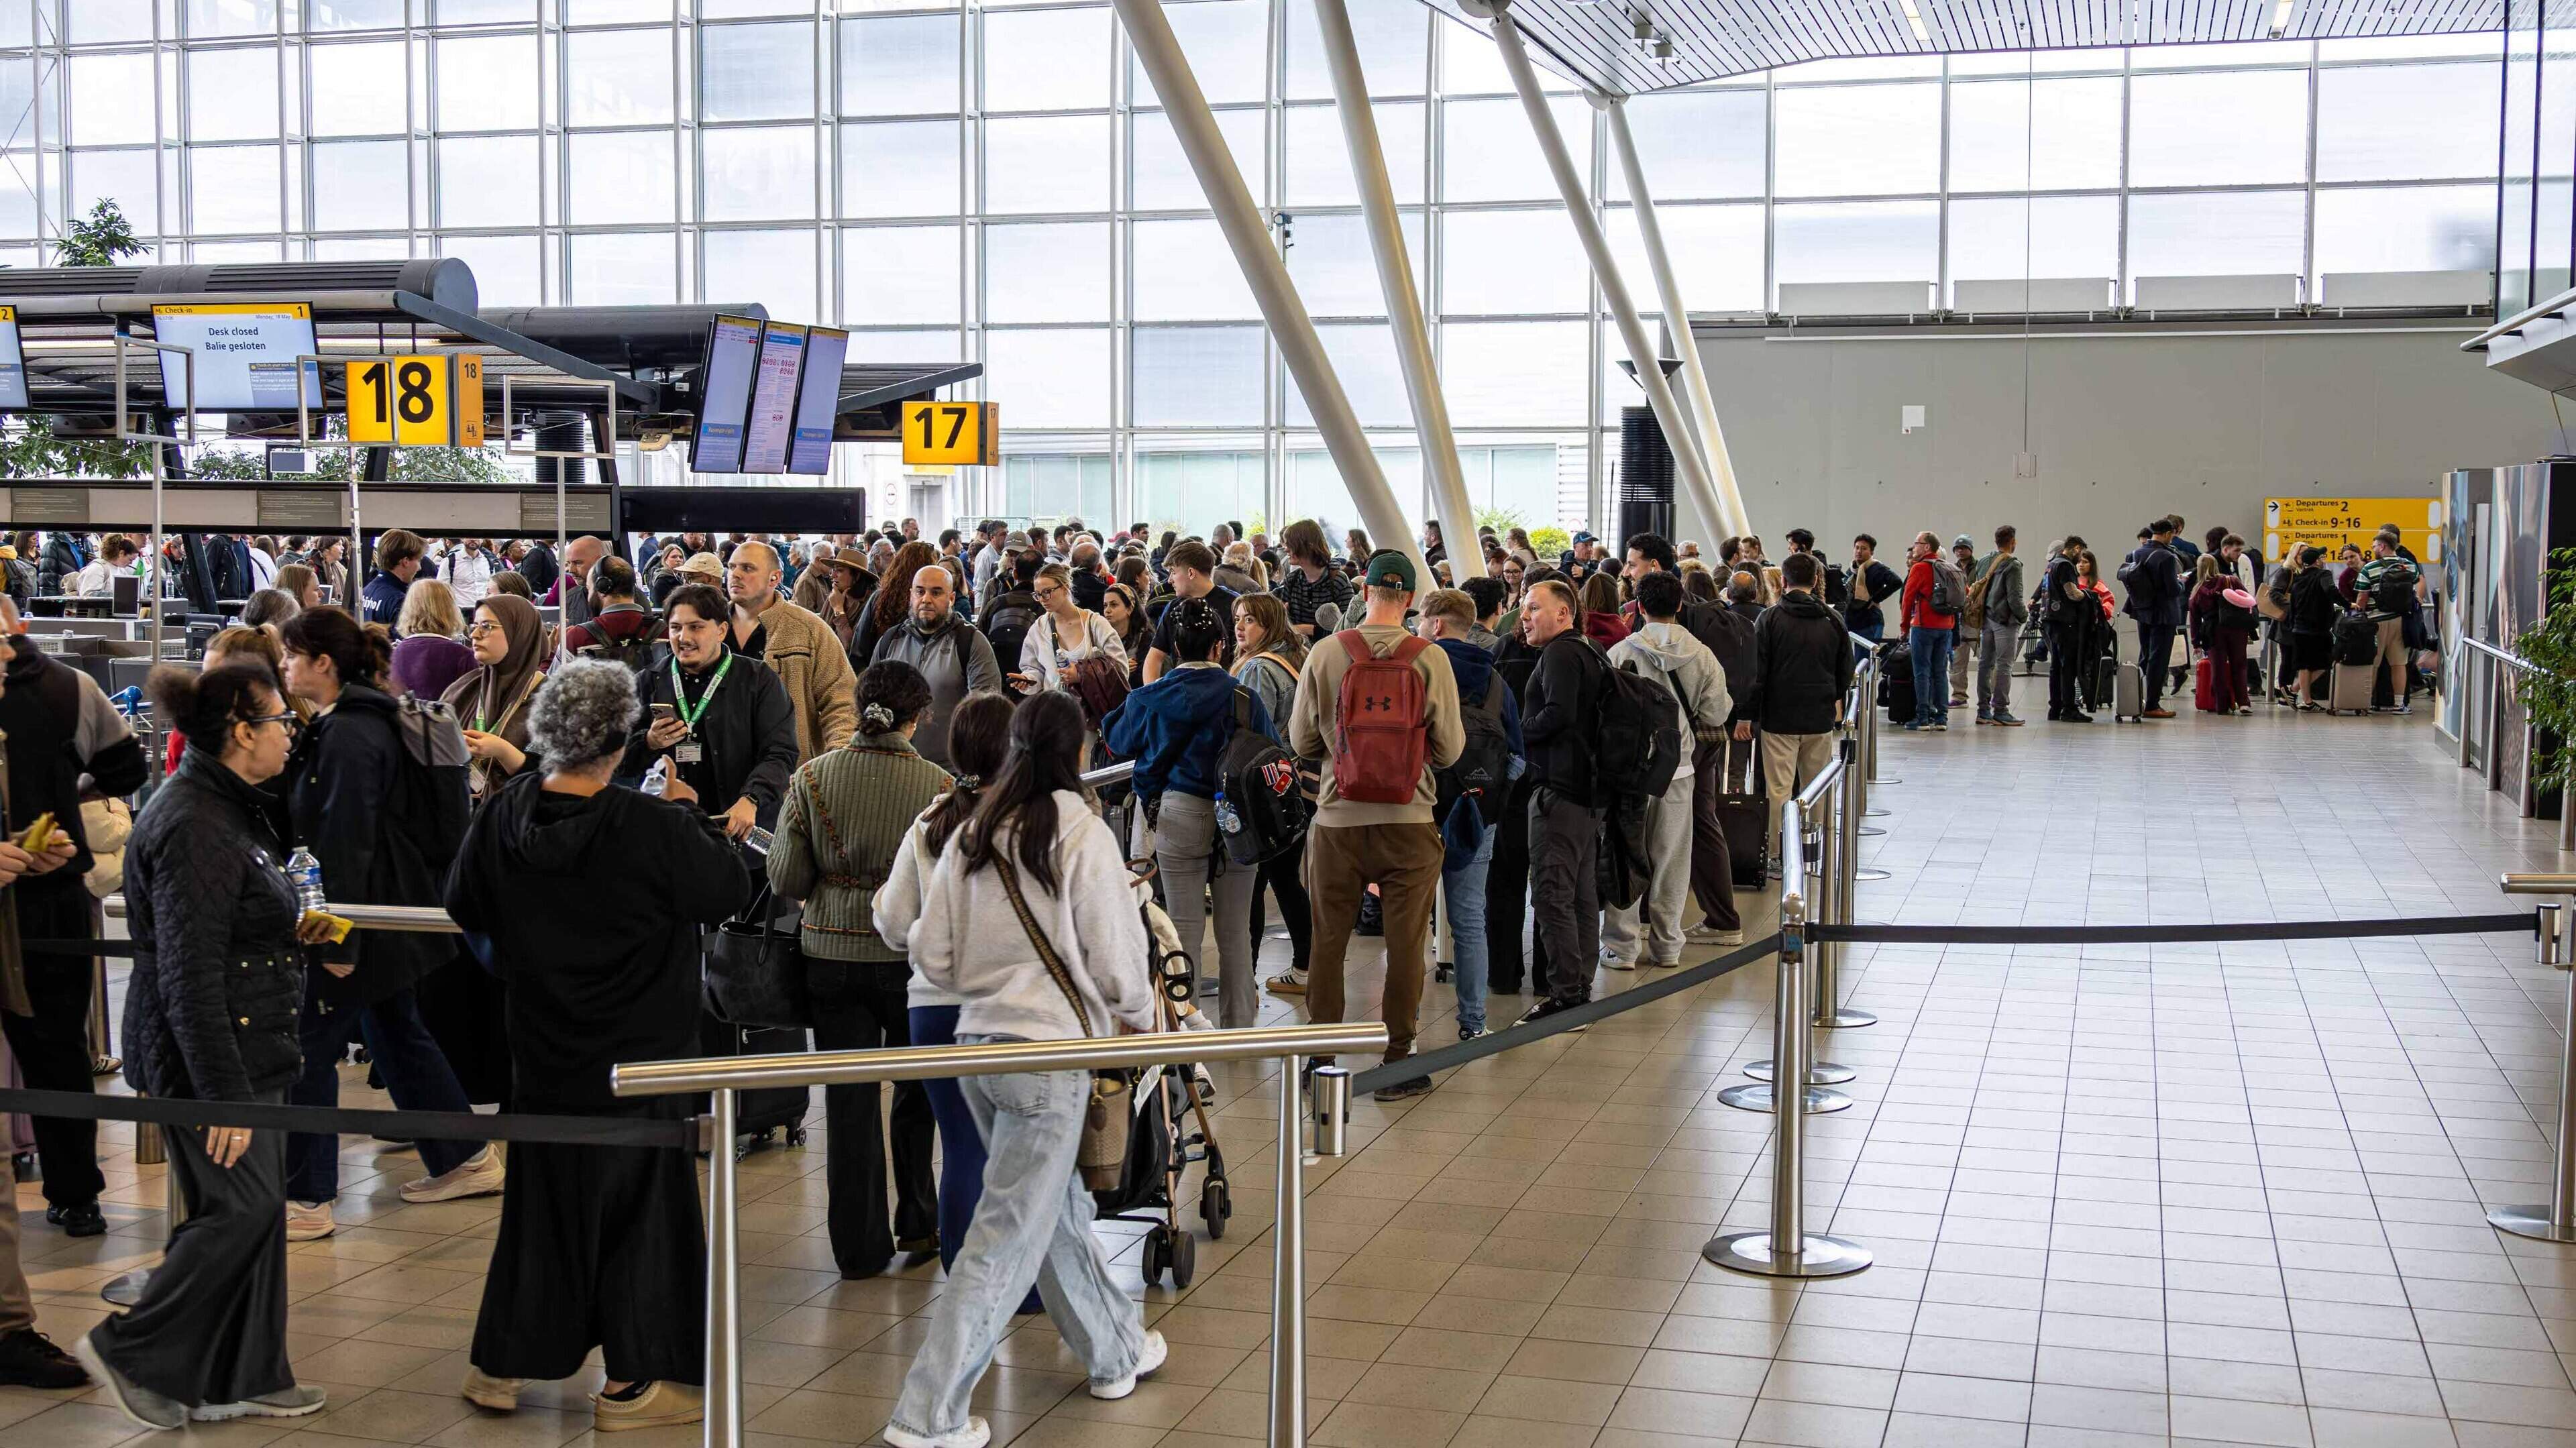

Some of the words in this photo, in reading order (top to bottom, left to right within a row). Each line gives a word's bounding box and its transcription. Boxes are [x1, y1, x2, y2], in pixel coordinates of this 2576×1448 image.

[1, 309, 9, 320] 2
[297, 306, 303, 317] 1
[209, 327, 229, 335] Desk
[231, 327, 258, 335] closed
[205, 342, 226, 350] Balie
[229, 342, 266, 352] gesloten
[464, 363, 476, 379] 18
[362, 361, 433, 423] 18
[990, 408, 996, 419] 17
[914, 407, 967, 449] 17
[2296, 500, 2339, 508] Departures
[2341, 501, 2349, 512] 2
[2331, 517, 2361, 528] 9-16
[2296, 532, 2339, 540] Departures
[2341, 534, 2347, 544] 1
